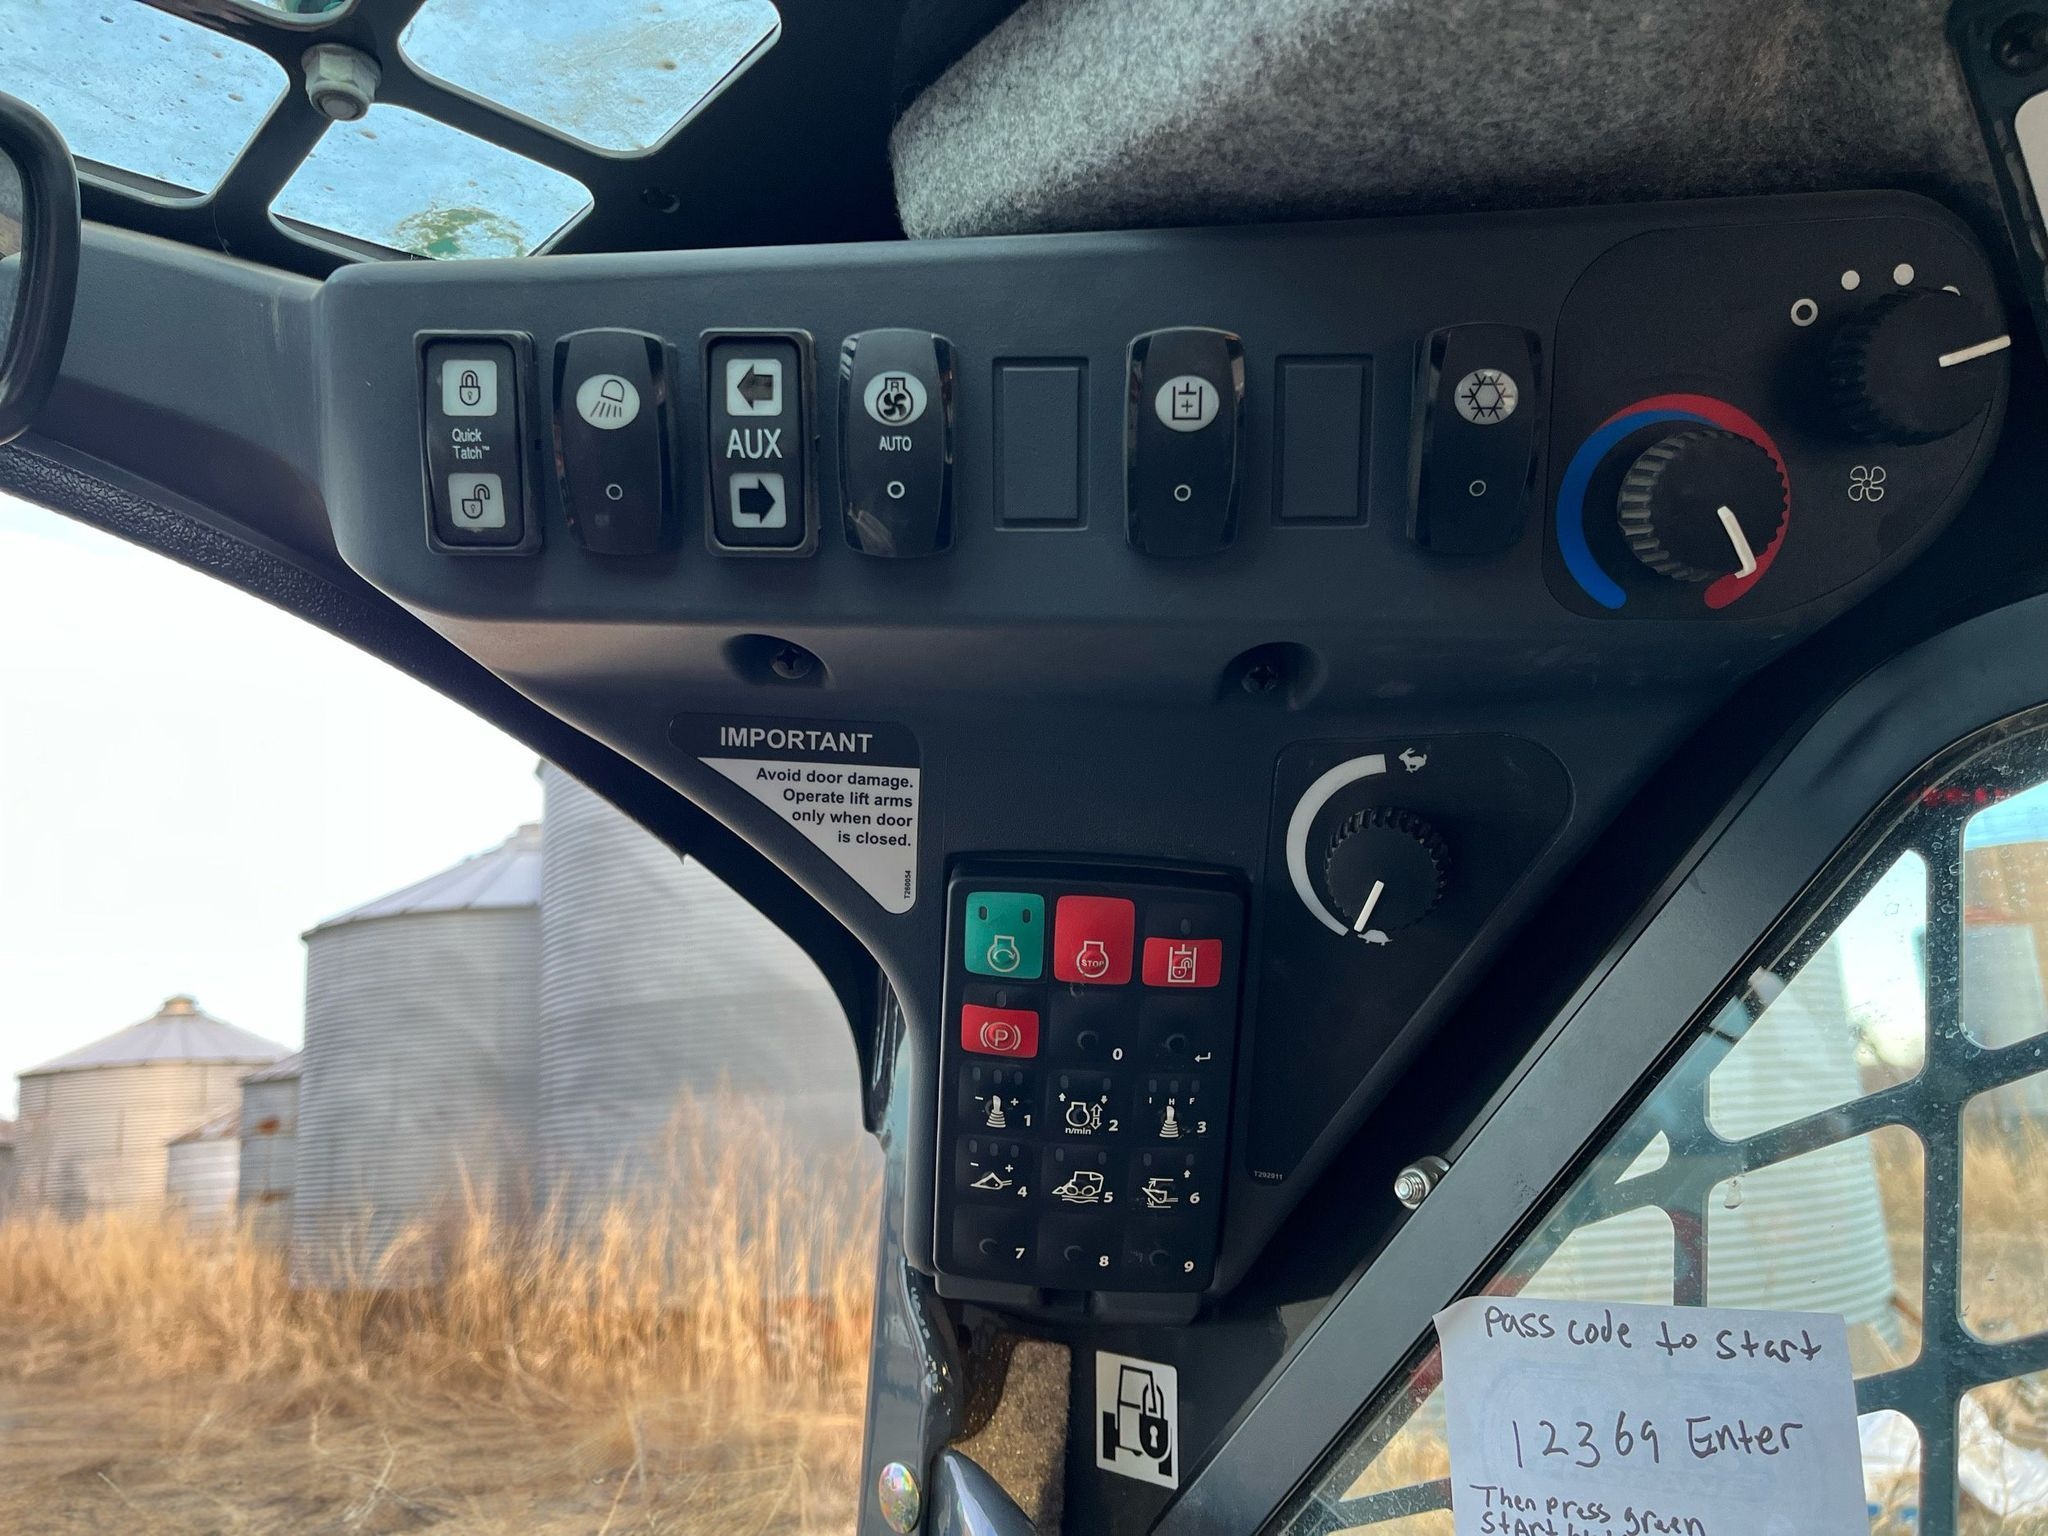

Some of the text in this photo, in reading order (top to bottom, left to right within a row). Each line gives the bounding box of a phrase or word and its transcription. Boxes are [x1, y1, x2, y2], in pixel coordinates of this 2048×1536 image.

[452, 428, 482, 442] Quick
[726, 429, 783, 459] AUX
[879, 436, 912, 452] AUTO
[720, 727, 873, 753] IMPORTANT
[756, 767, 914, 790] Avoid door damage.
[783, 788, 913, 807] Operate lift arms
[792, 810, 913, 827] only when door
[838, 831, 912, 846] is closed.
[1081, 959, 1105, 967] STOP
[995, 1029, 1009, 1046] P
[1112, 1048, 1123, 1061] 0
[1189, 1097, 1195, 1105] F
[1024, 1114, 1032, 1127] 1
[1108, 1119, 1119, 1131] 2
[1196, 1121, 1207, 1133] 3
[1065, 1127, 1092, 1135] n/min
[1017, 1186, 1028, 1198] 4
[1103, 1191, 1113, 1203] 5
[1189, 1192, 1200, 1204] 6
[1015, 1247, 1025, 1259] 7
[1099, 1255, 1109, 1267] 8
[1183, 1260, 1194, 1272] 9
[1485, 1305, 1556, 1339] Pass
[1567, 1310, 1632, 1348] code
[1656, 1321, 1698, 1357] to
[1686, 1415, 1803, 1459] Enter
[1470, 1484, 1536, 1511] Then
[1546, 1496, 1611, 1524] press
[1623, 1506, 1706, 1536] green
